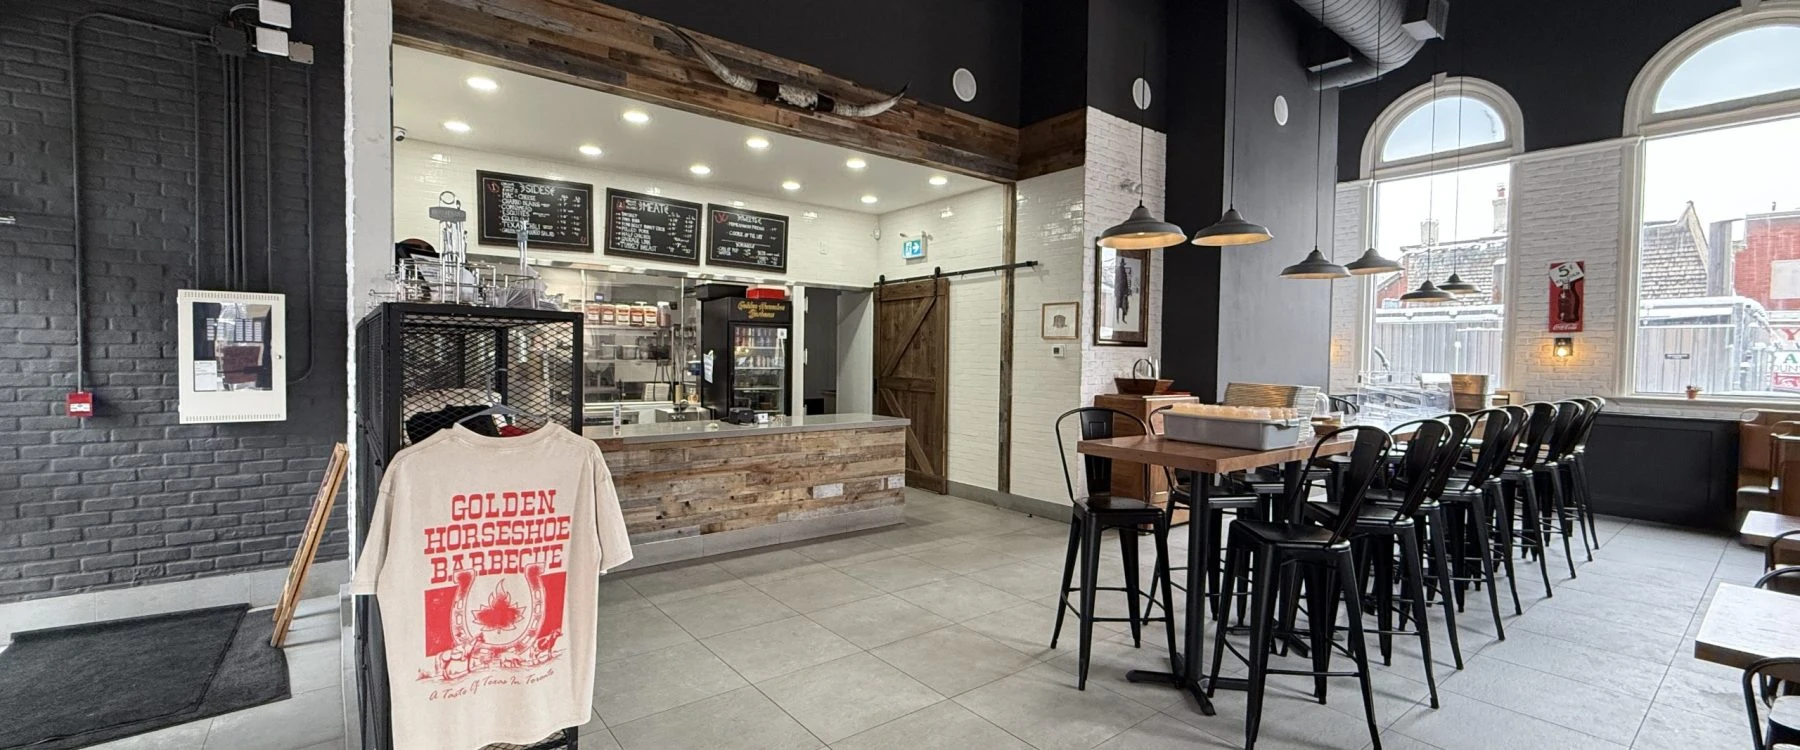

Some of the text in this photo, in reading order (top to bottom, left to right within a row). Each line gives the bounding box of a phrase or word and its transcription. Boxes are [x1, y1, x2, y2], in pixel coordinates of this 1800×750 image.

[526, 184, 552, 196] SIDES
[451, 489, 557, 521] GOLDEN
[424, 516, 571, 555] HORSESHOE
[430, 544, 563, 585] BARBECUE
[443, 687, 467, 699] Taste
[482, 675, 507, 686] Texas
[526, 668, 555, 685] Toronto
